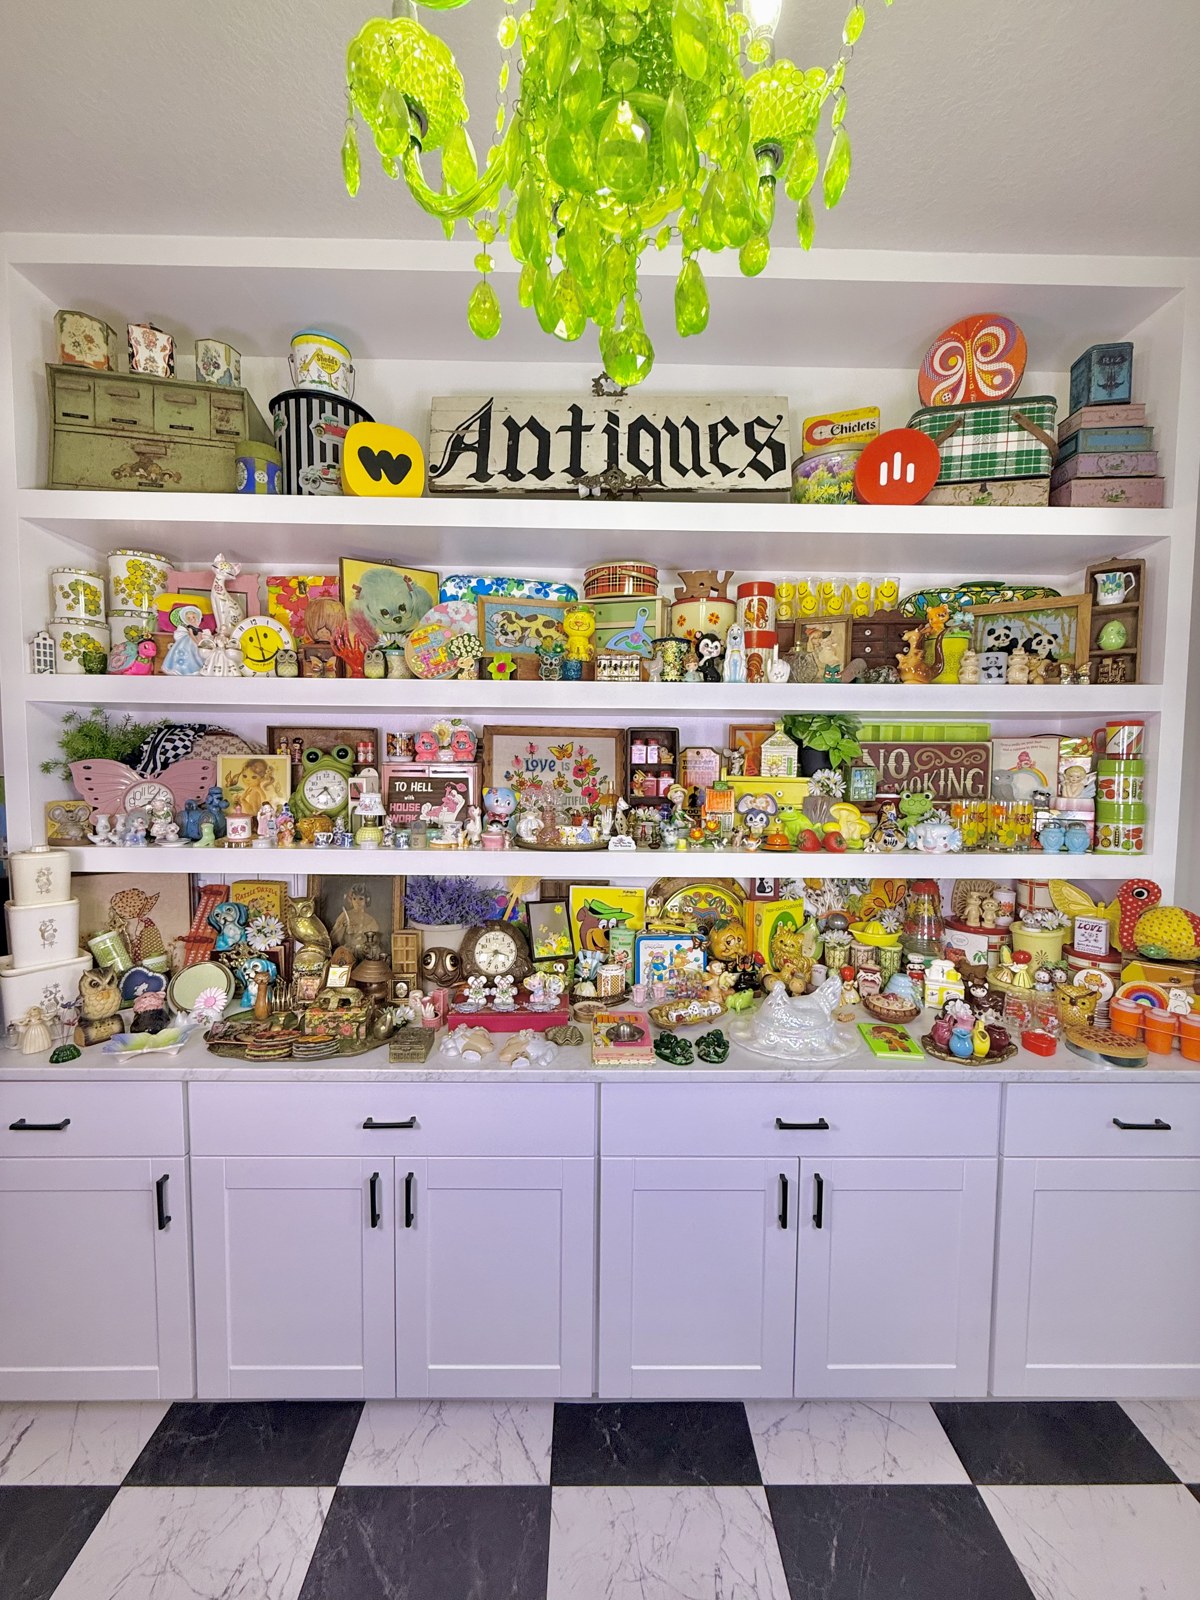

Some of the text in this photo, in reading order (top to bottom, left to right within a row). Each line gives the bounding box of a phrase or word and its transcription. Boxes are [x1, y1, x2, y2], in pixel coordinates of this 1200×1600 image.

[830, 421, 876, 436] Chiclets
[429, 397, 787, 488] Antiques
[862, 748, 911, 779] NO
[394, 781, 433, 792] TO HELL
[389, 802, 420, 812] HOUSE
[389, 814, 418, 823] WORK
[1077, 922, 1103, 933] LOVE
